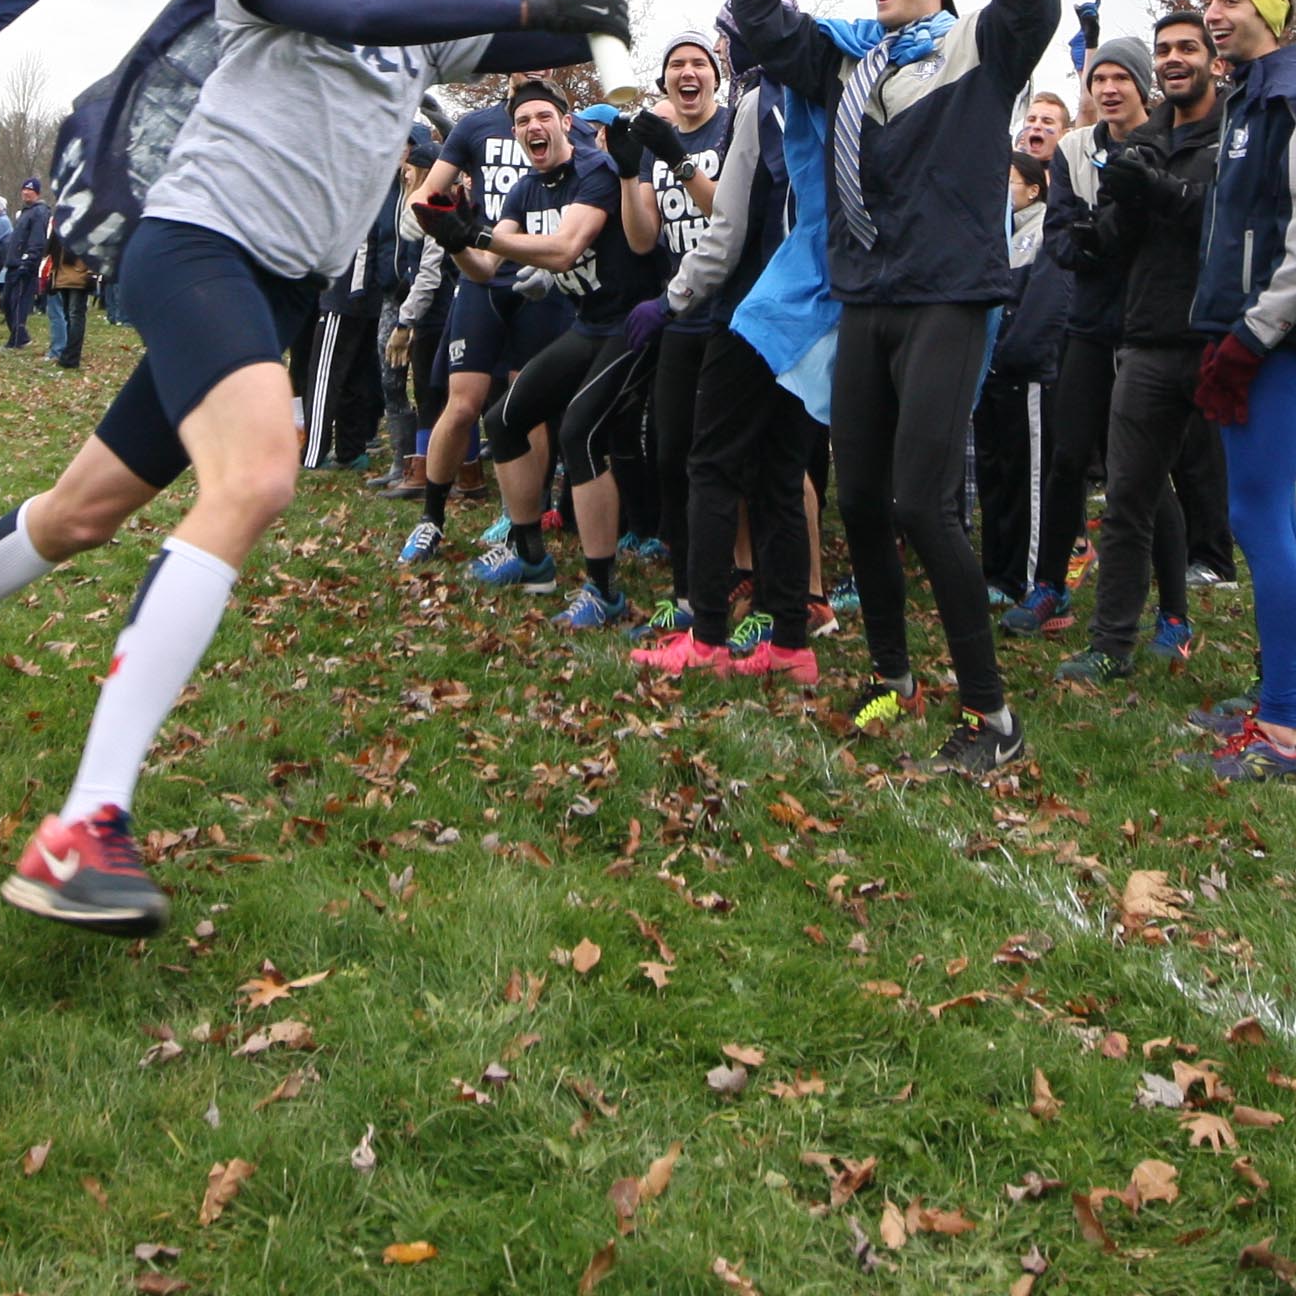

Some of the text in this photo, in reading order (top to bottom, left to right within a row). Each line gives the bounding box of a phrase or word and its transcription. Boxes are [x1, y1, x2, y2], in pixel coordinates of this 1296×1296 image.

[485, 138, 533, 166] FIN
[481, 166, 529, 194] YO
[652, 149, 720, 190] FID
[656, 188, 703, 220] OU
[526, 205, 570, 235] FIN
